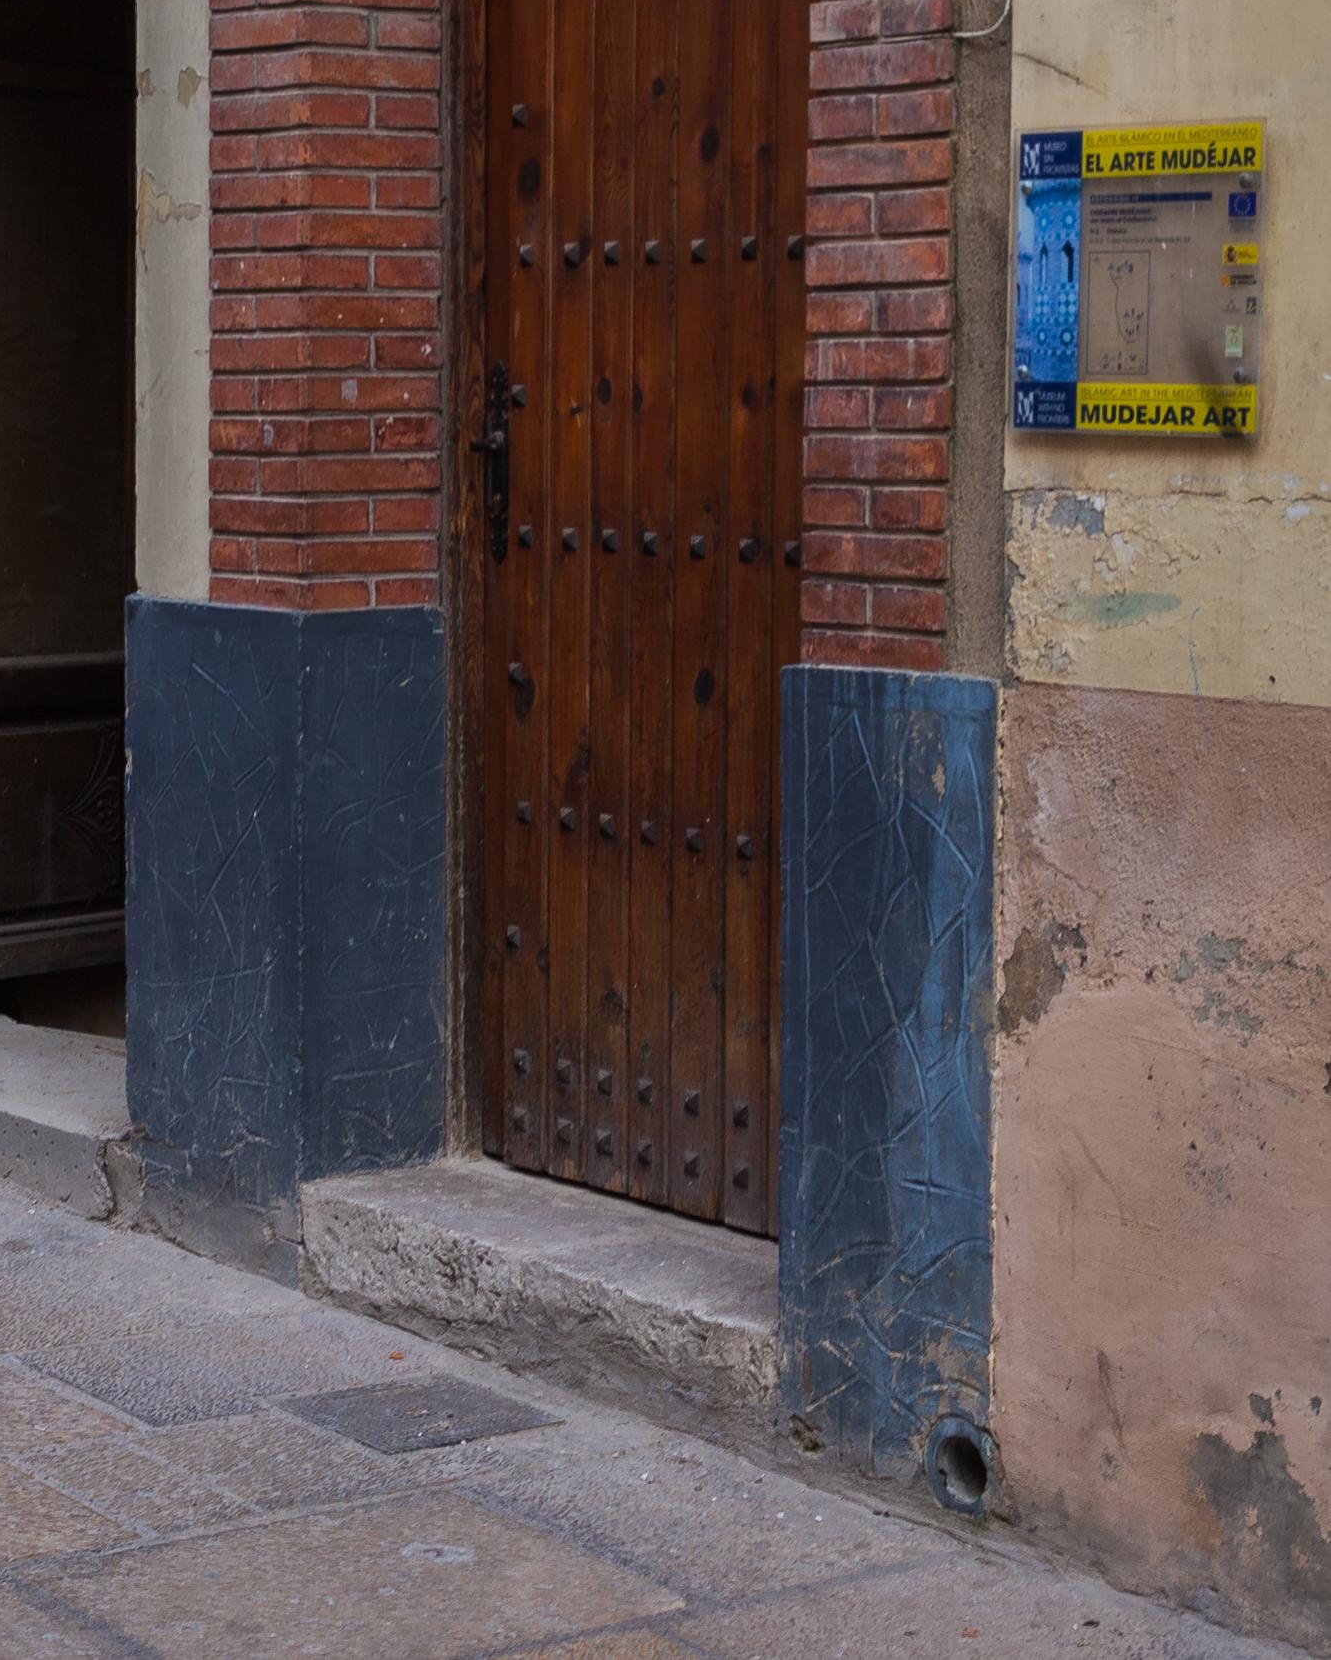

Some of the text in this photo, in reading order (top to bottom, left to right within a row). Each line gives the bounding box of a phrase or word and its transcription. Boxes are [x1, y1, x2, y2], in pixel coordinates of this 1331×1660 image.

[1086, 140, 1256, 172] EL ARTE MUDÉJAR
[1121, 388, 1138, 399] ART
[1141, 389, 1150, 399] IN
[1153, 388, 1168, 399] THE
[1080, 404, 1251, 427] MUDEJAR ART
